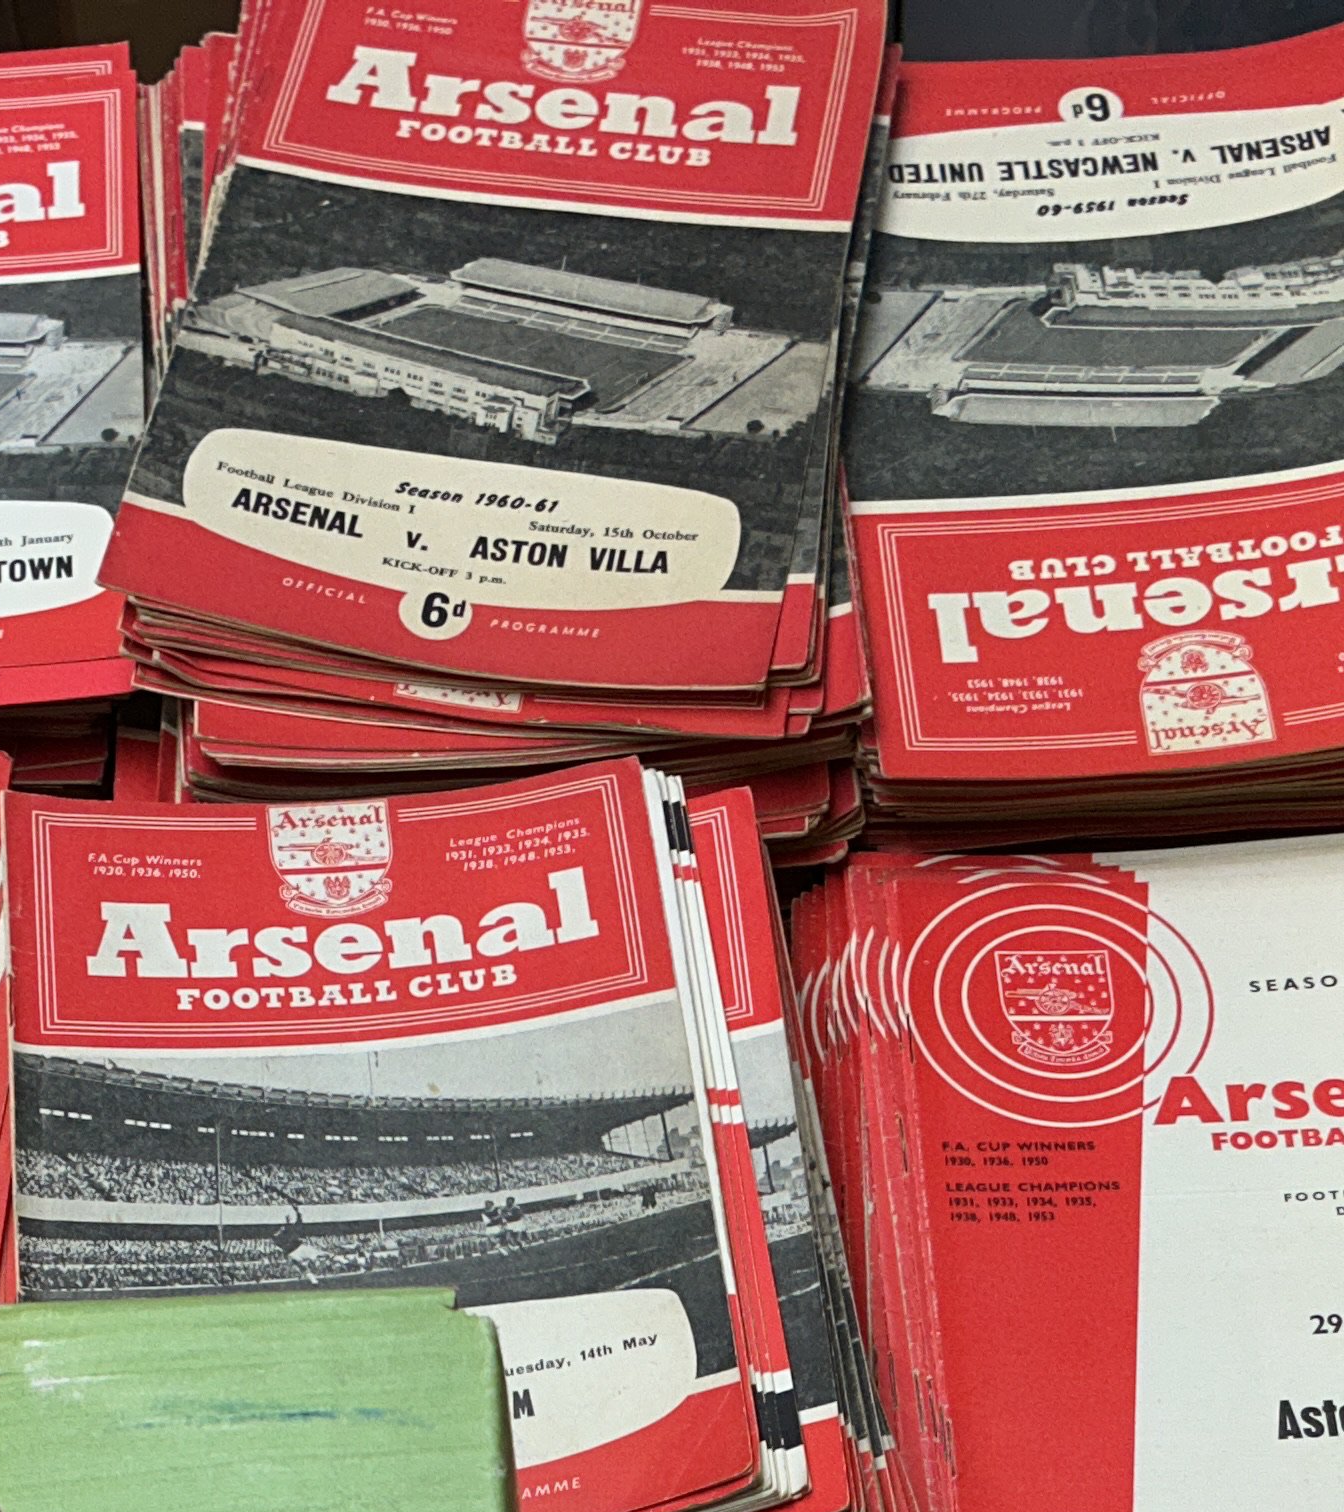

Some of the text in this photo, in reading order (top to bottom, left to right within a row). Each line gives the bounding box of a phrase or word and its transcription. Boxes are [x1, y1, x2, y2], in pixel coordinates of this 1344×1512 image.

[325, 45, 801, 146] Arsenal
[1072, 92, 1111, 122] 6d
[395, 119, 712, 167] FOOTBALL CLUB
[889, 125, 1333, 184] ARSENAL NEWCASTLE UNITED
[216, 460, 275, 487] Football
[394, 480, 560, 515] Season 1960-61
[20, 532, 75, 550] January
[231, 487, 670, 575] ARSENAL ASTON VILLA
[528, 520, 699, 544] Saturday, October
[1009, 524, 1344, 580] FOOTBALL CLUB
[419, 590, 467, 630] 6d
[147, 854, 203, 868] Winners
[86, 865, 601, 979] Arsenal
[176, 963, 518, 1013] FOOTBALL CLUB
[579, 1332, 659, 1364] 14th May
